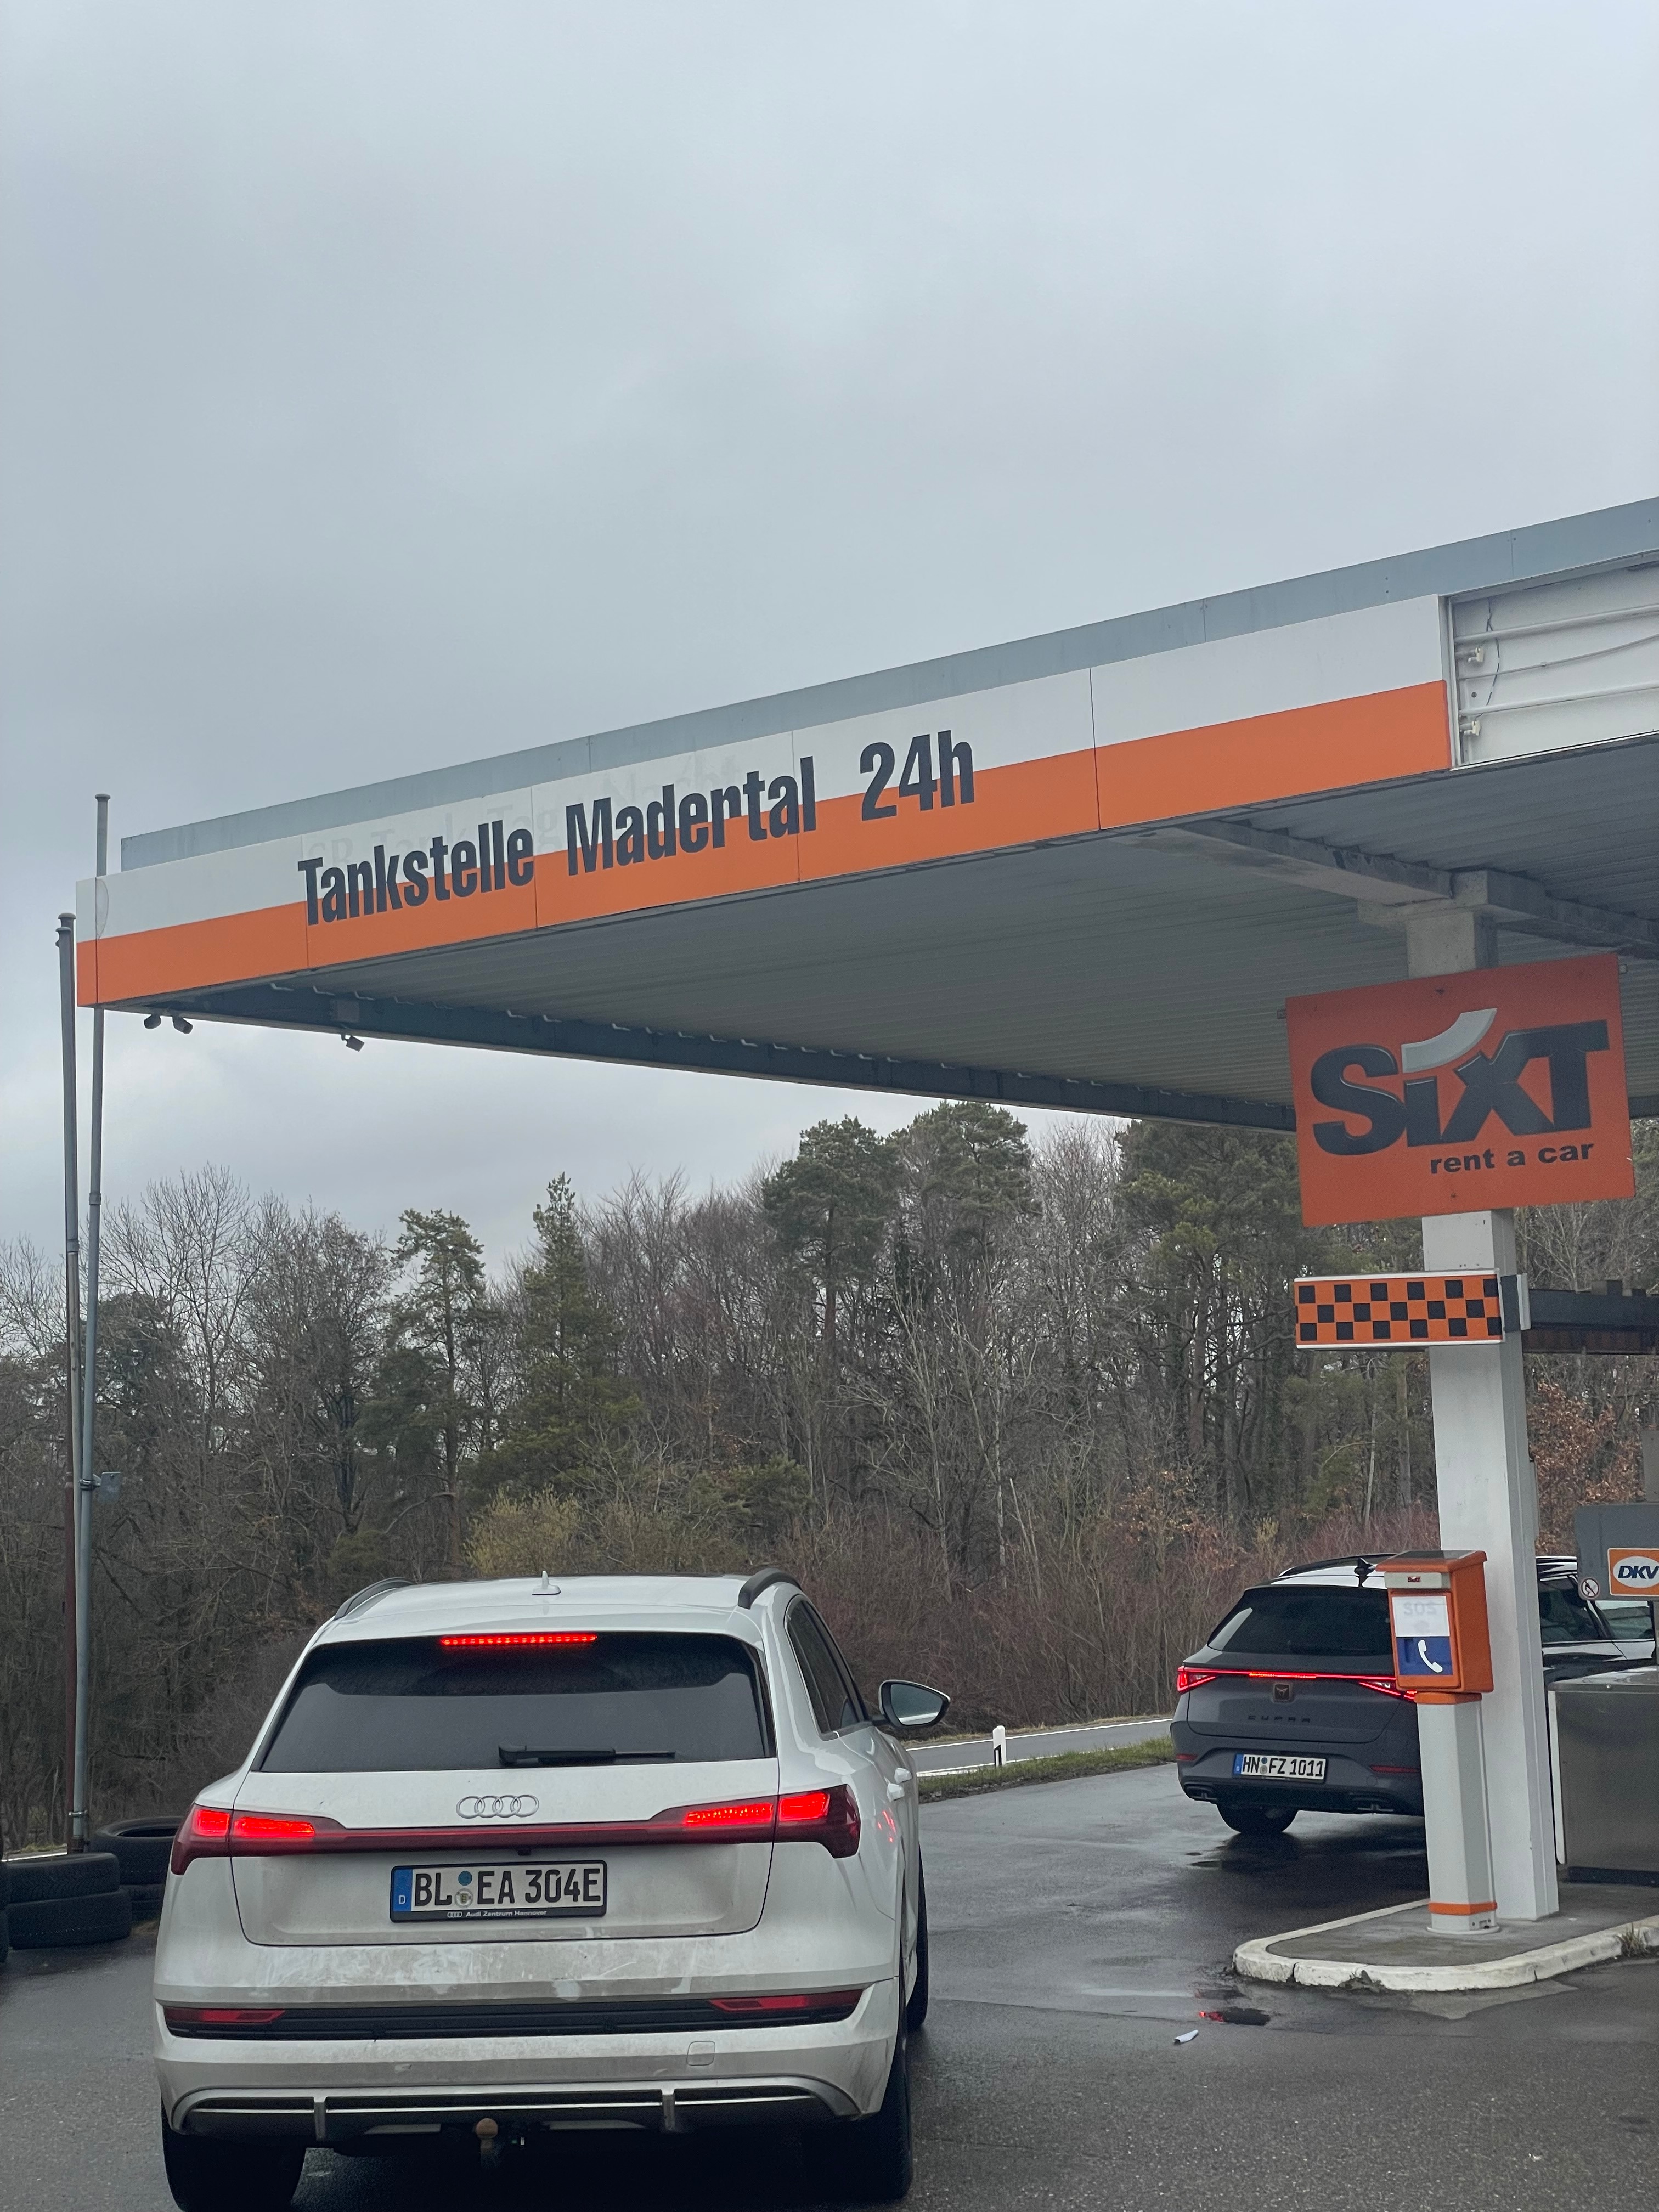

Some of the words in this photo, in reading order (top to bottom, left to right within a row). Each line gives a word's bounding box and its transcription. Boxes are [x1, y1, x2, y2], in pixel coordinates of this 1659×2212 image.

[298, 820, 534, 926] Tankstelle
[566, 756, 816, 876] Madertal
[860, 730, 974, 821] 24h
[1430, 1148, 1495, 1174] rent
[1507, 1150, 1526, 1167] a
[1538, 1143, 1594, 1164] car
[1617, 1565, 1659, 1579] DKV
[1242, 1756, 1260, 1773] HN
[1268, 1758, 1286, 1774] FZ
[1289, 1759, 1323, 1777] 1011
[398, 1895, 407, 1905] D
[414, 1872, 453, 1906] BL
[477, 1870, 515, 1904] EA
[524, 1868, 602, 1904] 304E
